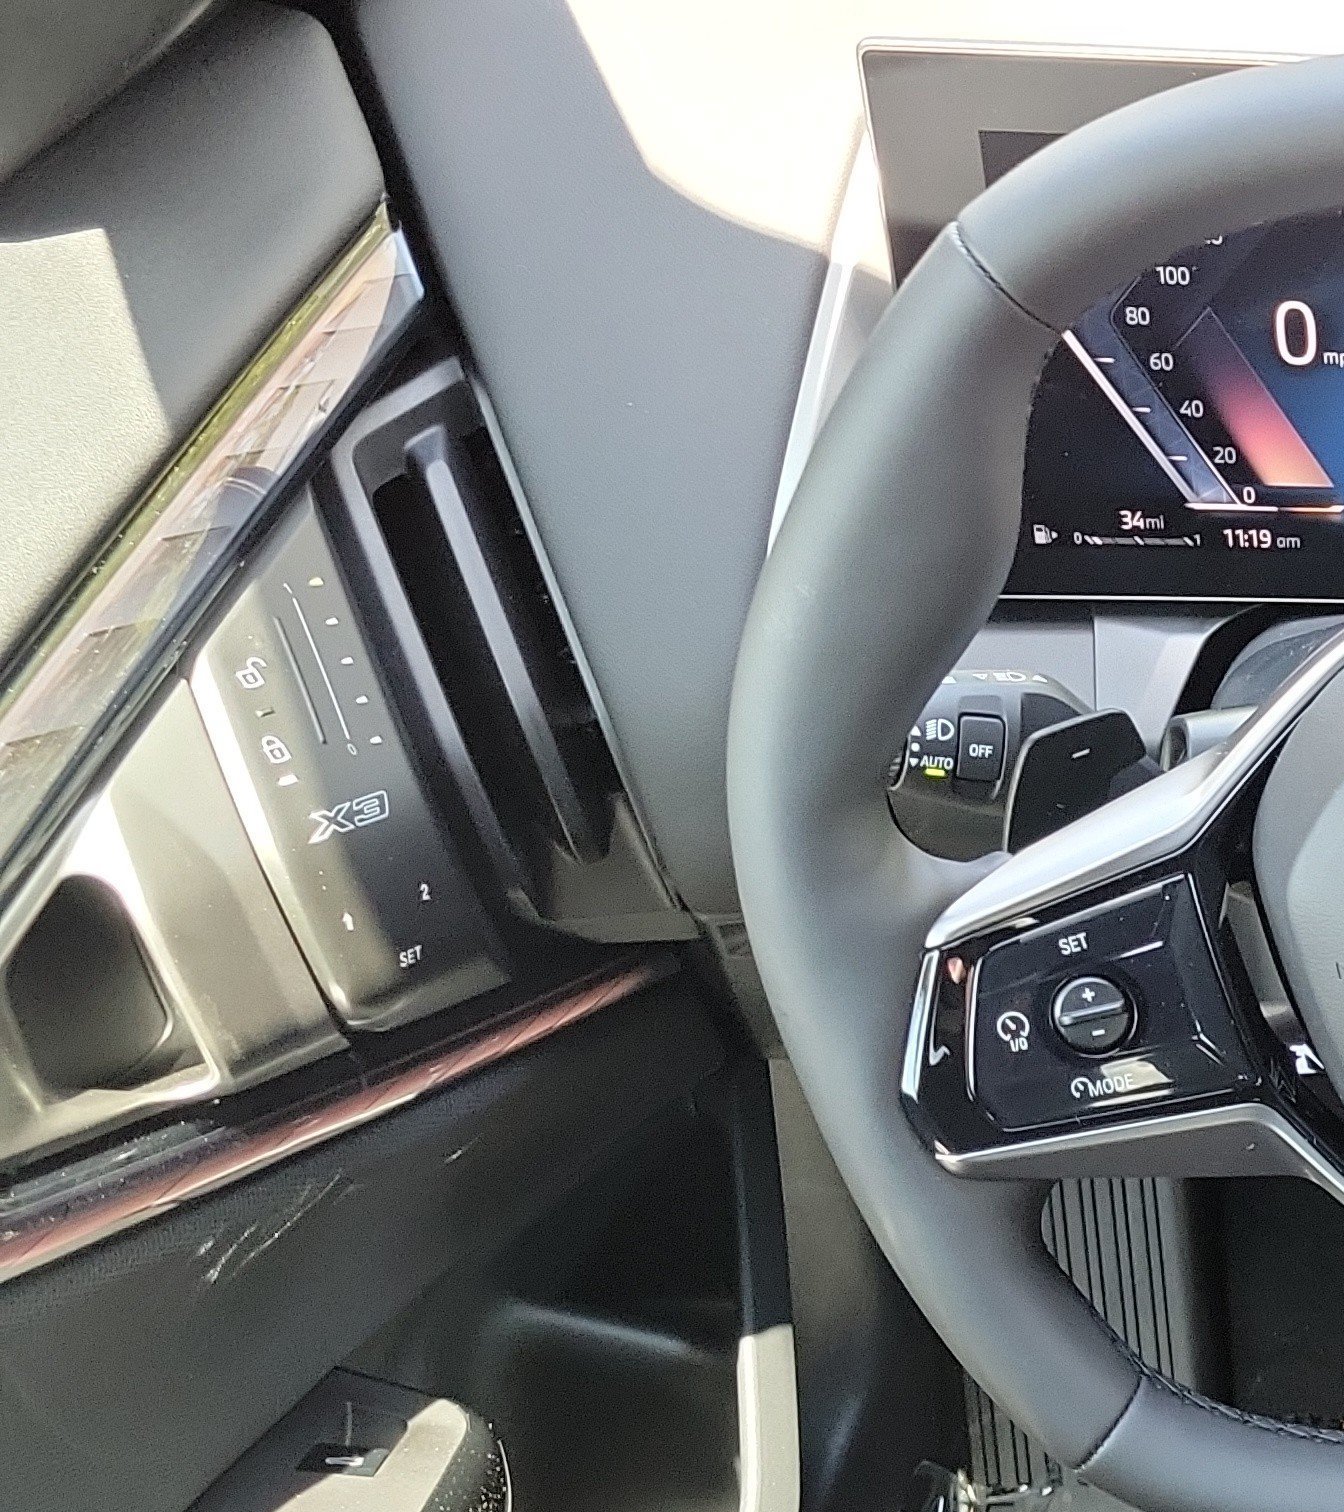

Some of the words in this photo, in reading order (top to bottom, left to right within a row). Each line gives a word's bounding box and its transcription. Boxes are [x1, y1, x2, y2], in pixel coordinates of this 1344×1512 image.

[1155, 265, 1190, 285] 100
[1124, 306, 1150, 326] 80
[1274, 299, 1318, 367] 0
[1149, 352, 1174, 371] 60
[1179, 399, 1204, 418] 40
[1213, 445, 1237, 465] 20
[1242, 486, 1256, 504] 0
[1118, 509, 1145, 530] 34
[1072, 531, 1083, 545] 0
[1222, 528, 1272, 549] 11:19
[1276, 536, 1301, 549] am
[968, 743, 993, 760] OFF
[920, 754, 954, 770] AUTO
[306, 789, 390, 845] X3
[419, 883, 432, 901] 2
[1057, 932, 1088, 957] SET
[398, 944, 424, 968] SET
[1088, 1072, 1135, 1098] MODE
